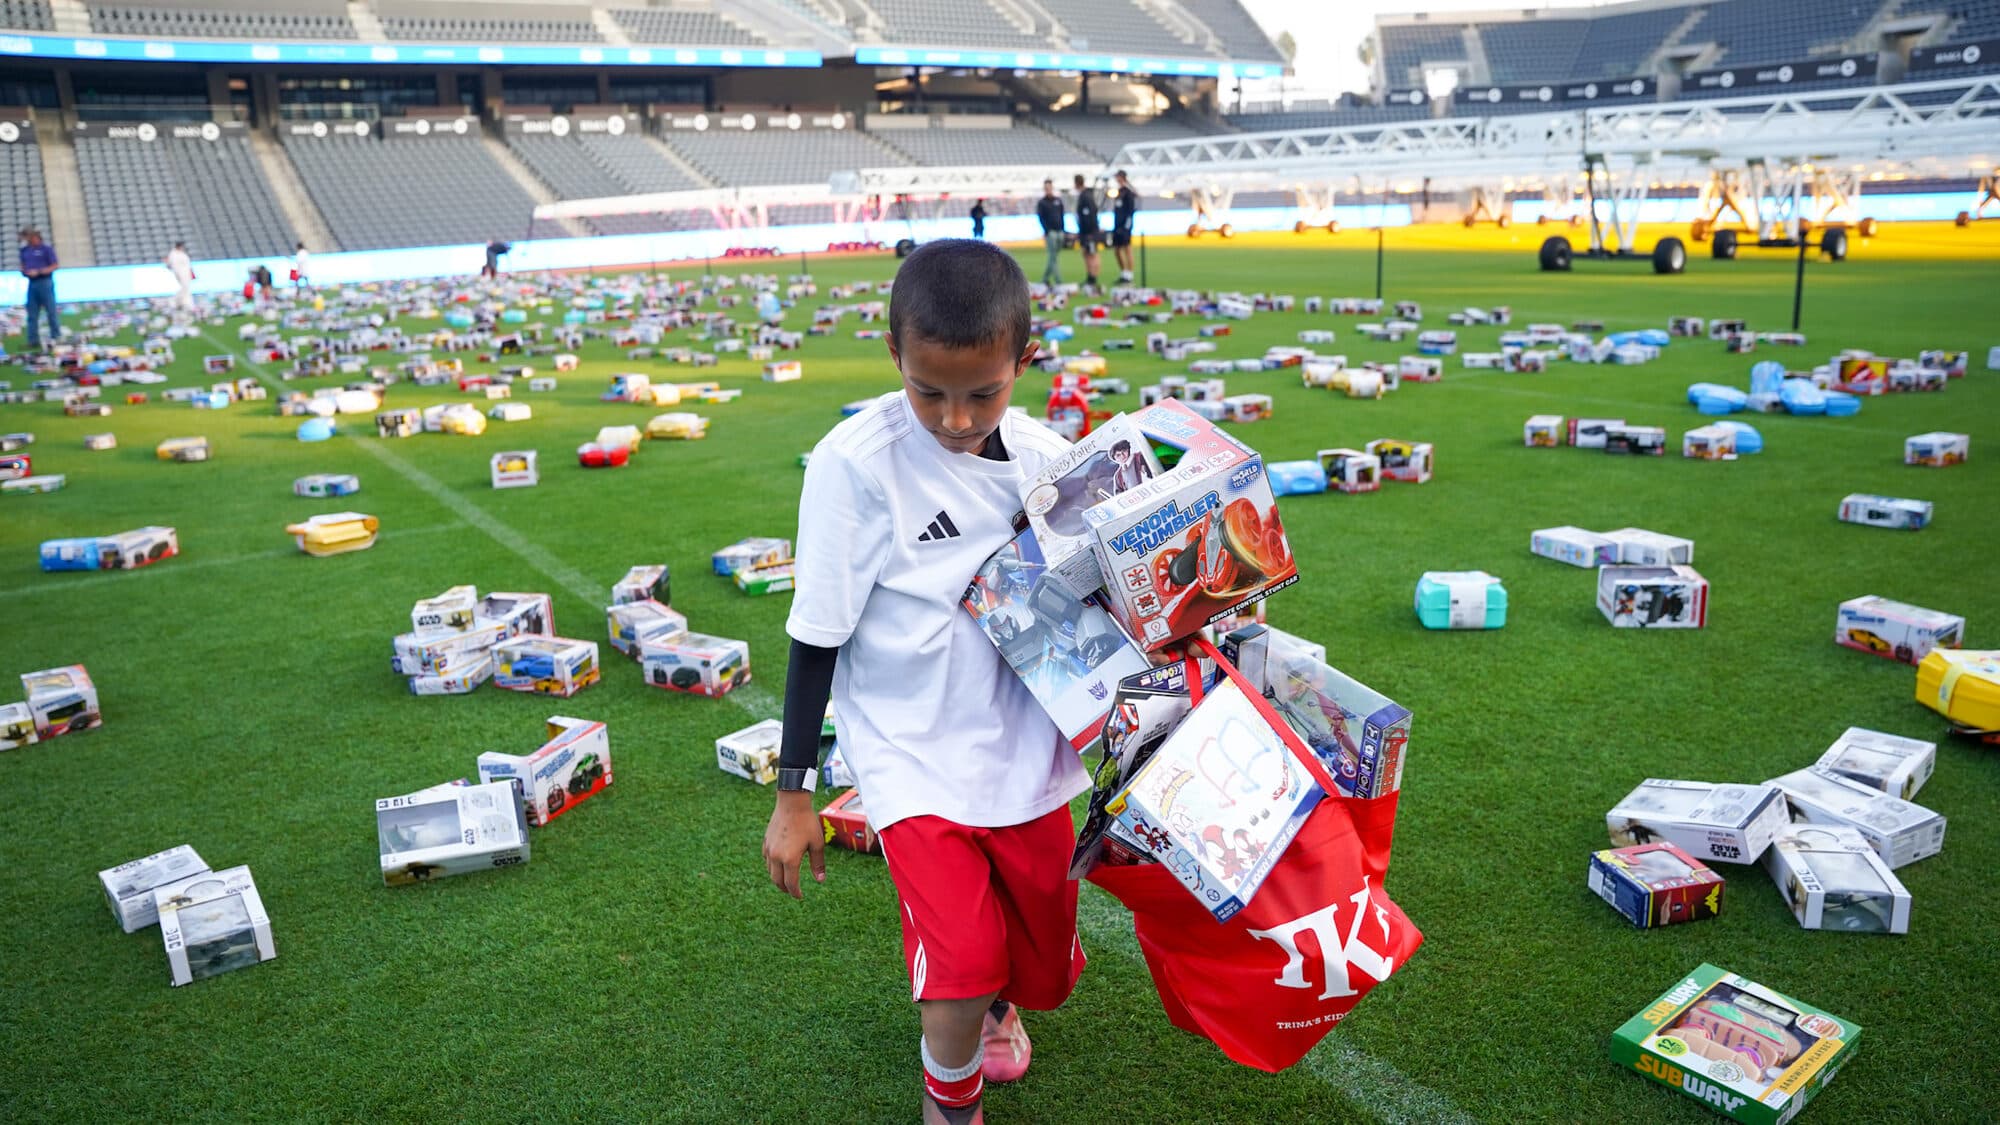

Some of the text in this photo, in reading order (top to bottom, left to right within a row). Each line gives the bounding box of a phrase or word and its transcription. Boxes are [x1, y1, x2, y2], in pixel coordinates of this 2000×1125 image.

[1069, 439, 1097, 465] Potter
[1231, 464, 1258, 483] WORLD
[1108, 500, 1181, 555] VENOM
[1132, 490, 1221, 558] TUMBLER
[1209, 575, 1299, 624] REMOTE CONTROL STUNT CAR
[1713, 851, 1742, 859] STAR
[1642, 977, 1704, 1025] SUBWAY
[1276, 1017, 1321, 1030] TRINA'S
[1657, 1038, 1676, 1050] 12
[1634, 1053, 1747, 1115] SUBWAY
